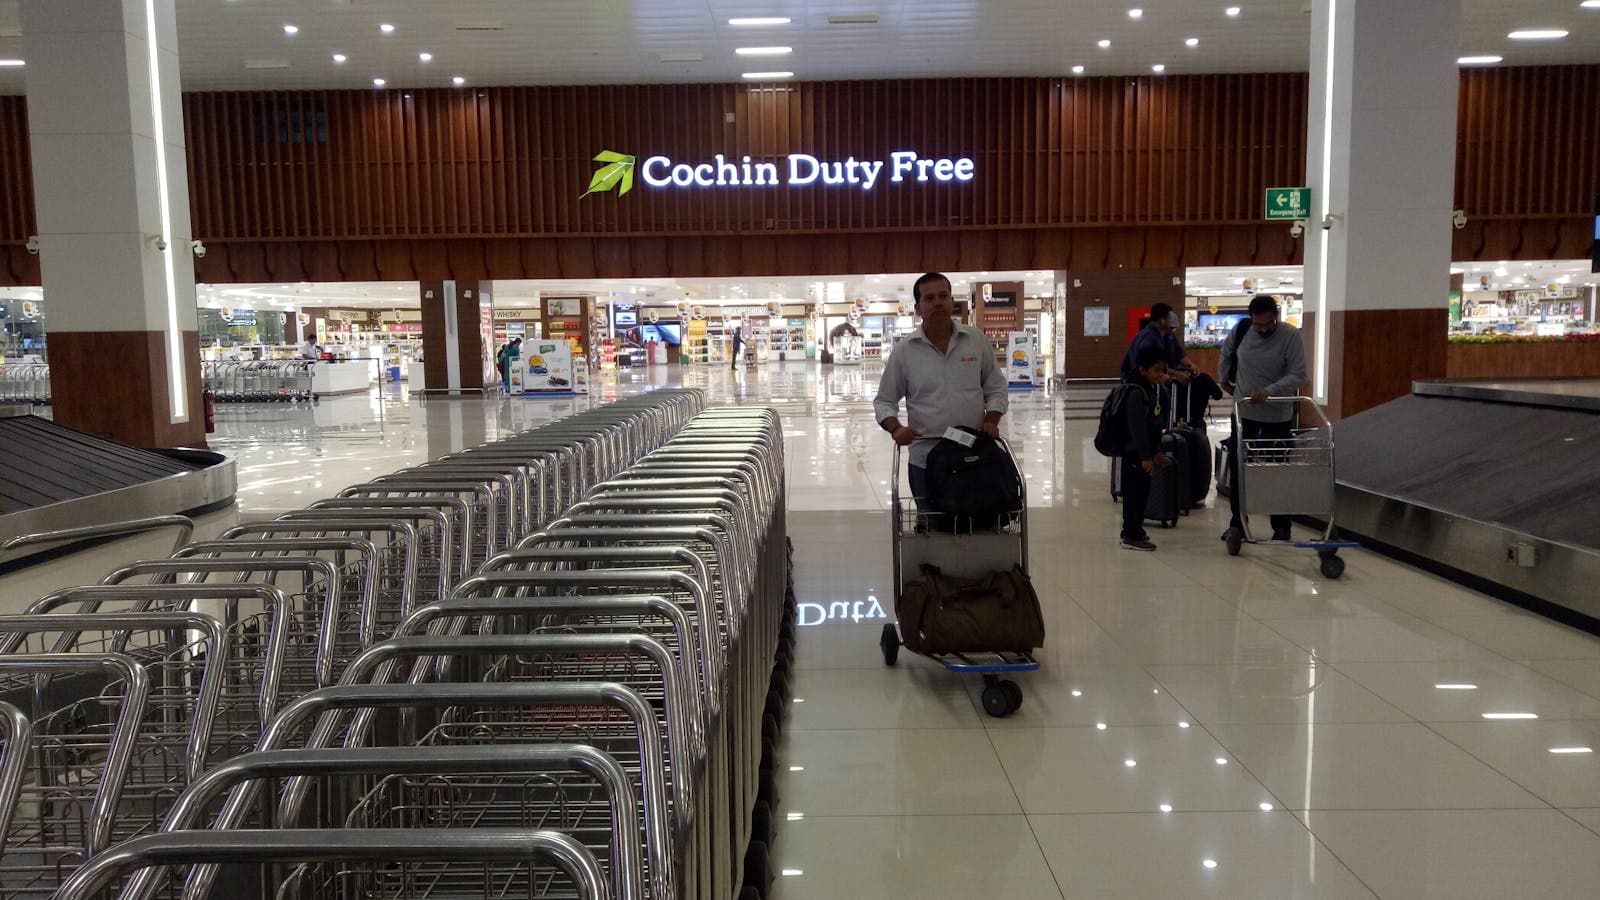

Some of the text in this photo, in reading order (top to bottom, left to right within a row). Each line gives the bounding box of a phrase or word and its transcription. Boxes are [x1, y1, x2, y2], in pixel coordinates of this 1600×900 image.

[642, 151, 974, 190] Cochin Duty Free
